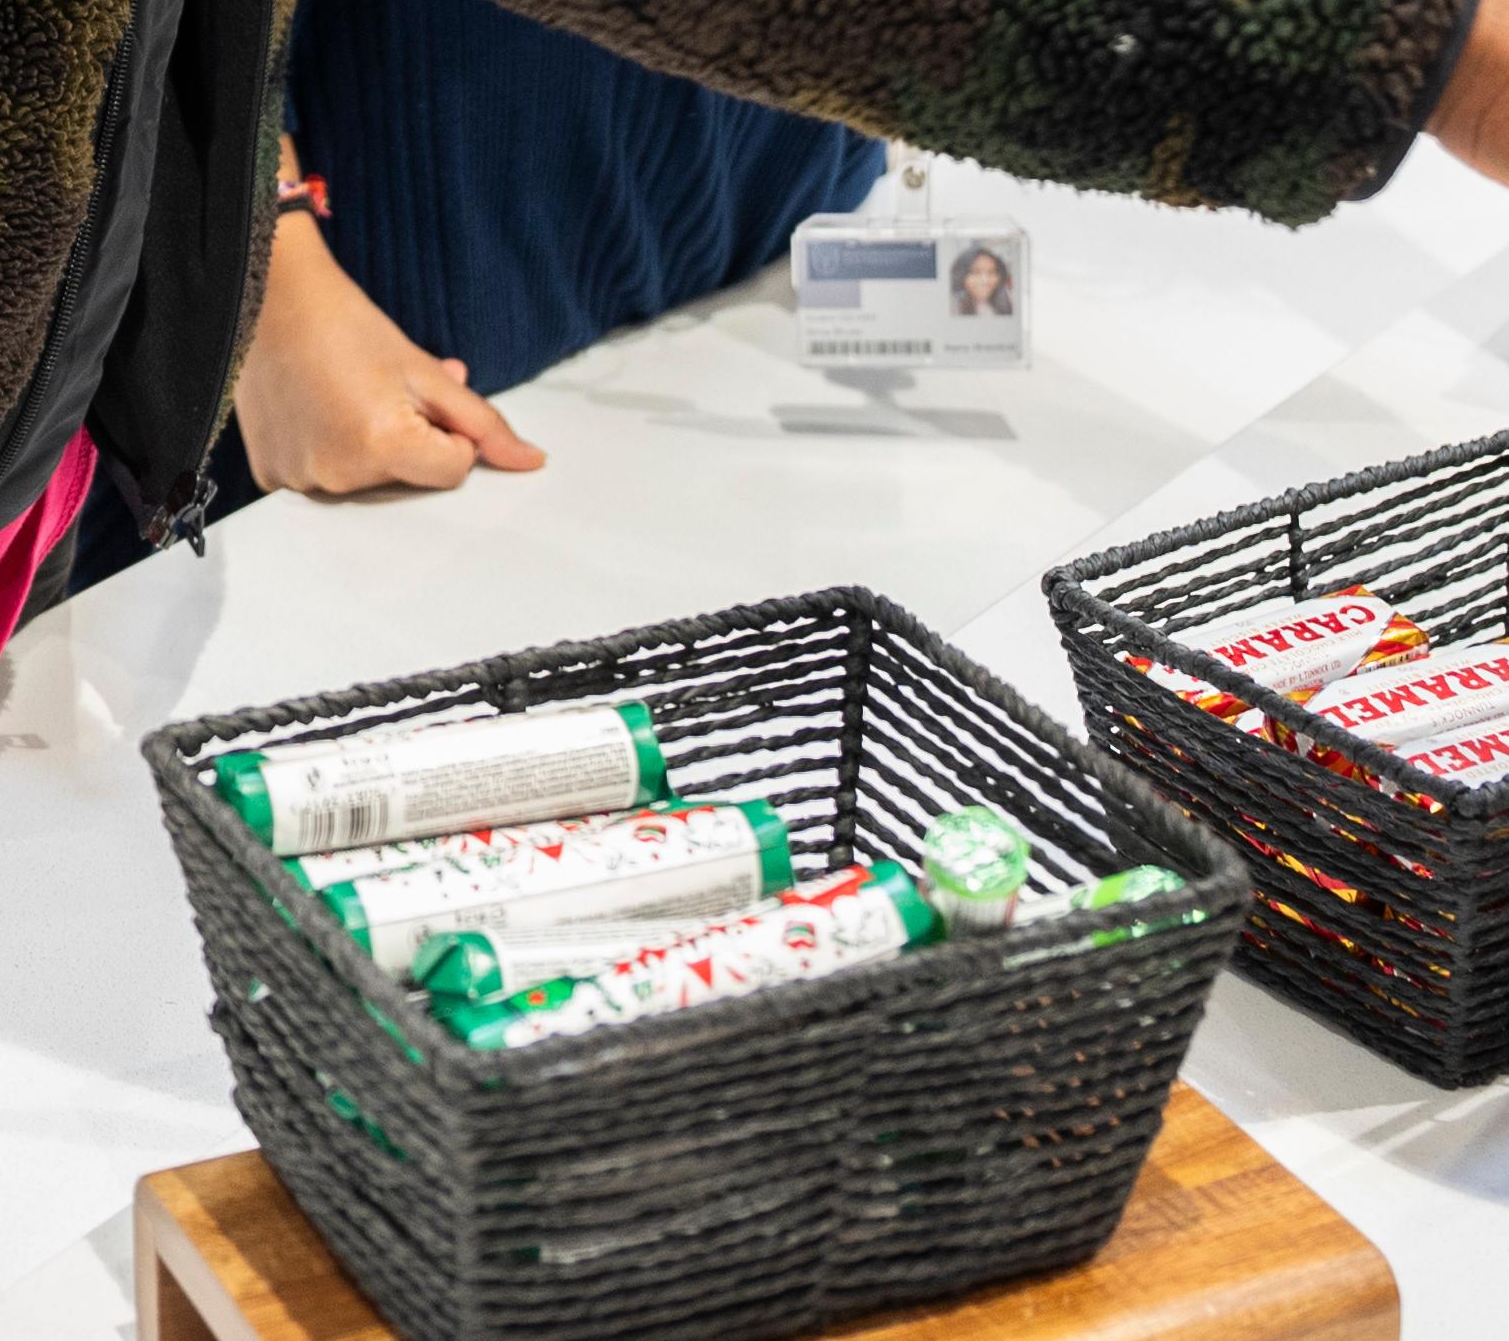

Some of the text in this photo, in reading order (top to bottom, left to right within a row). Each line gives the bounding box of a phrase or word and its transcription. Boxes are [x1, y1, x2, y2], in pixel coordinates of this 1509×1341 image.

[1213, 605, 1376, 667] CARAM
[1318, 658, 1509, 728] ARAMEL
[1406, 730, 1509, 775] MEL
